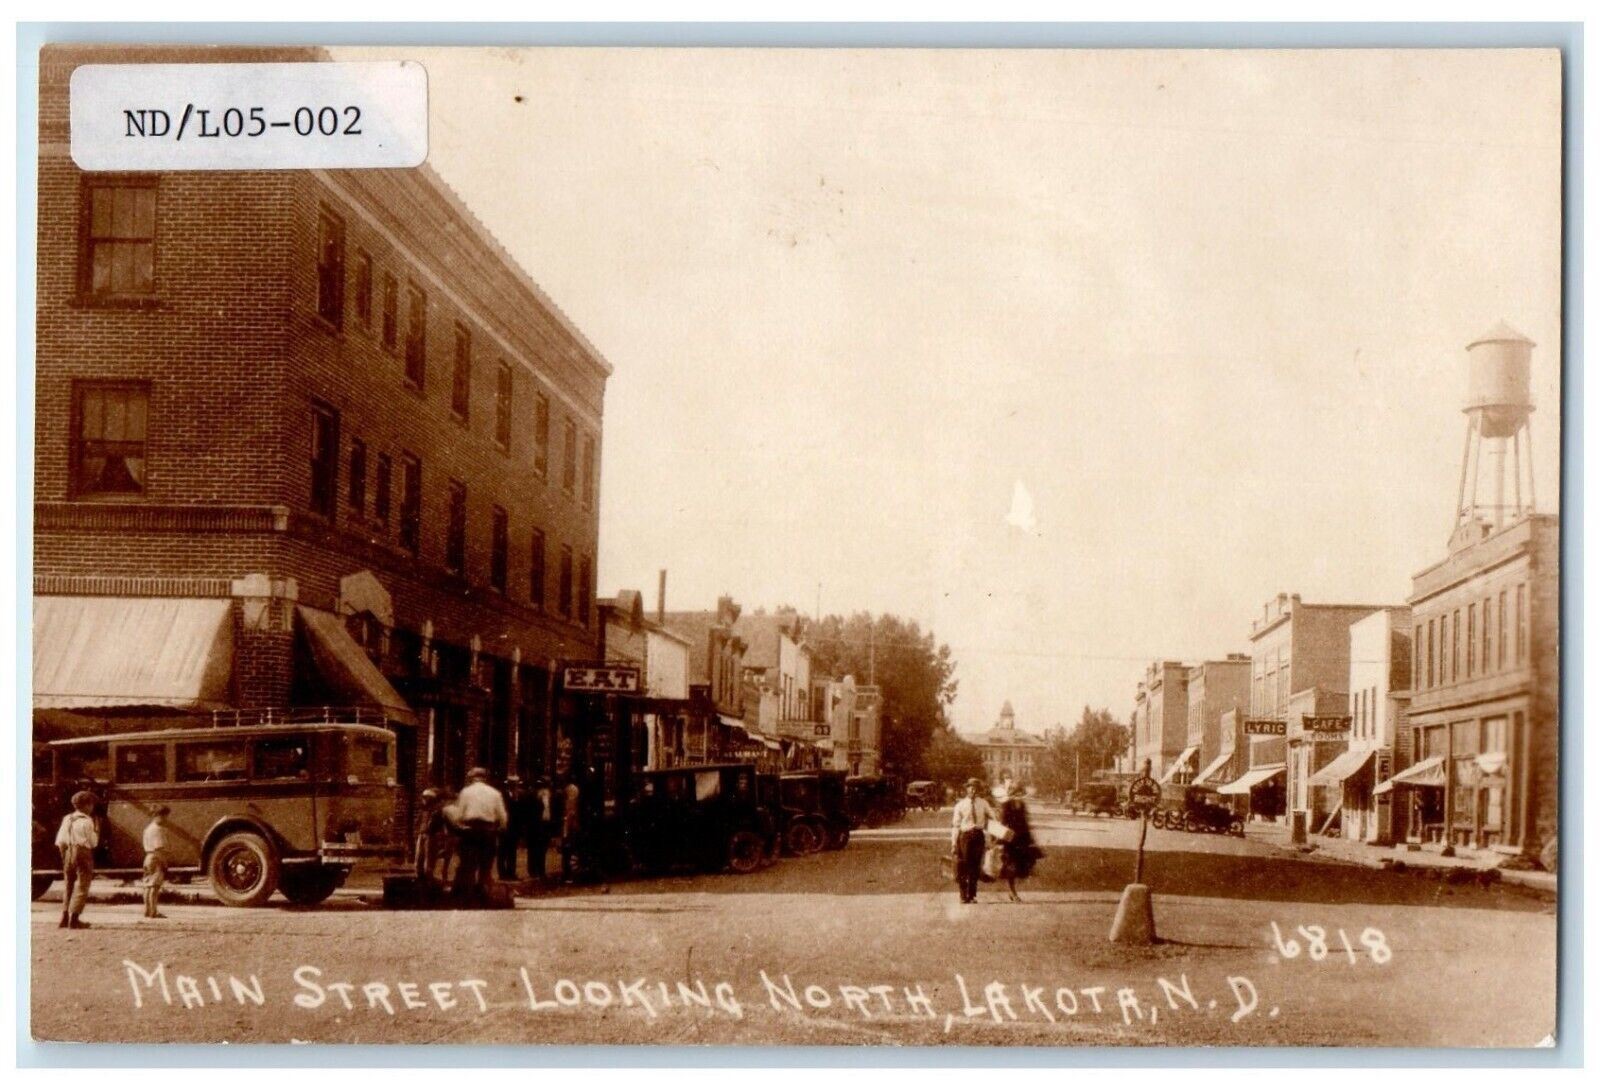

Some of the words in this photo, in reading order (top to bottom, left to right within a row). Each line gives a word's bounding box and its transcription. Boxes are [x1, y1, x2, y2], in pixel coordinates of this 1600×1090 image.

[567, 670, 635, 689] EAT
[1247, 722, 1286, 733] LYRIC
[1312, 720, 1343, 730] CAFE
